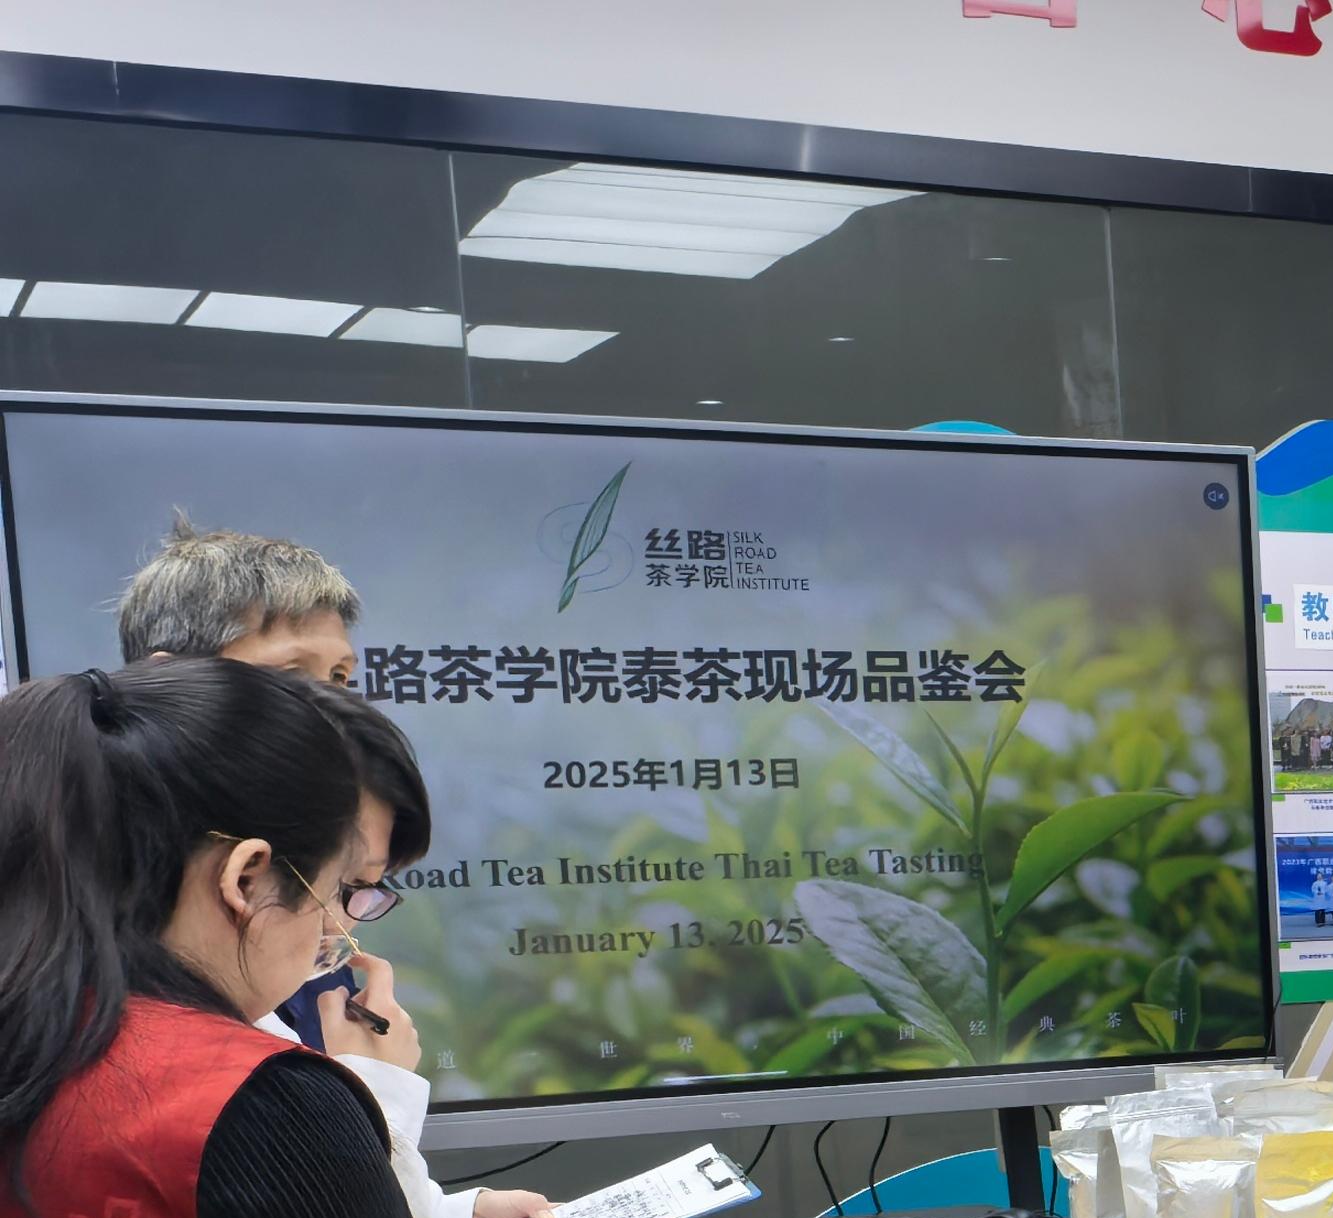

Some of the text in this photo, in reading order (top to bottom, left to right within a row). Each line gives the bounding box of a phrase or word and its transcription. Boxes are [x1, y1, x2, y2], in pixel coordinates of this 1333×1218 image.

[644, 528, 726, 561] 丝路
[734, 531, 764, 544] SILK
[735, 547, 777, 560] ROAD
[736, 562, 764, 574] TEA
[646, 563, 730, 589] 茶学院
[737, 578, 810, 591] INSTITUTE
[344, 646, 1027, 705] 路茶学院泰茶现场品鉴会
[542, 757, 801, 792] 2025年1月13日
[481, 859, 545, 888] Tea
[557, 855, 705, 886] Institute
[714, 851, 792, 879] Thai
[802, 850, 860, 877] Tea
[868, 847, 985, 878] Tasting
[509, 926, 656, 957] January
[728, 917, 805, 946] 2025
